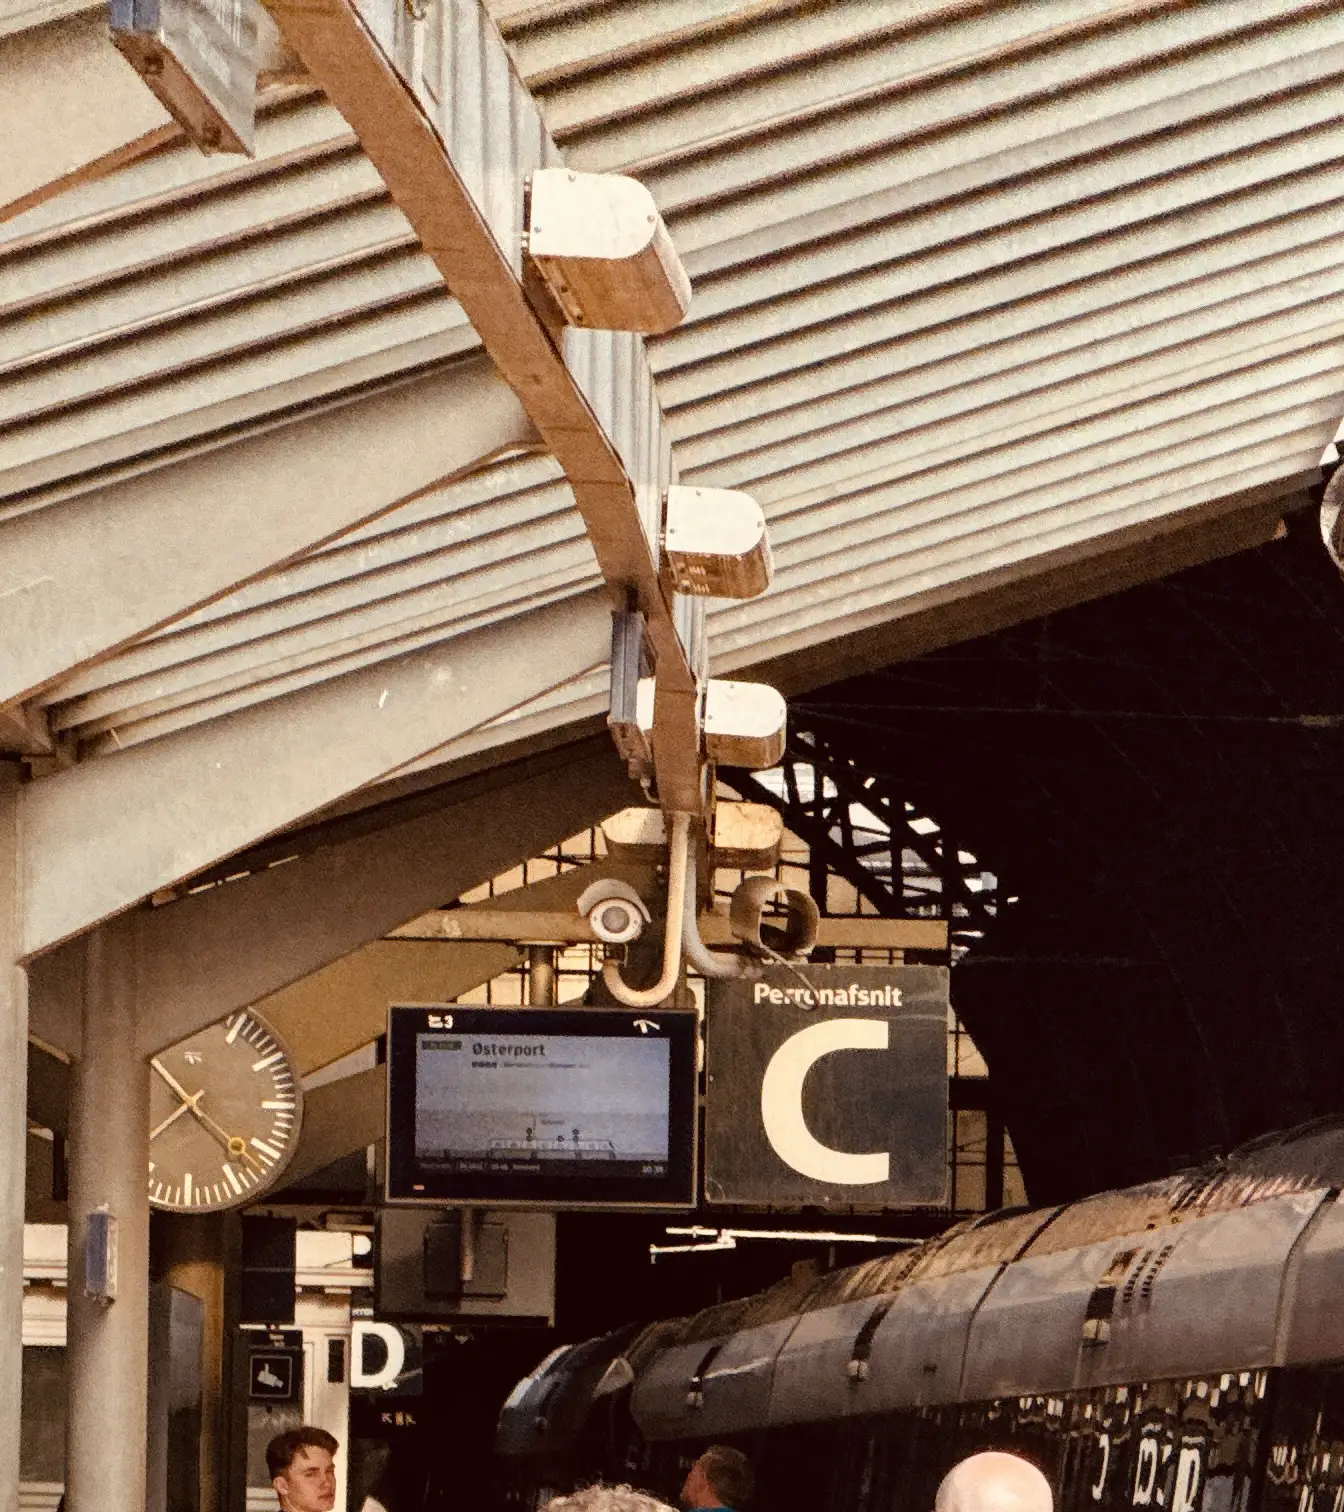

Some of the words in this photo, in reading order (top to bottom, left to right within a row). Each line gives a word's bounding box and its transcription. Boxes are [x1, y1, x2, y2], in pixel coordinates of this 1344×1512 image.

[472, 1042, 545, 1058] Østerport
[761, 1018, 889, 1185] C
[350, 1321, 405, 1388] D
